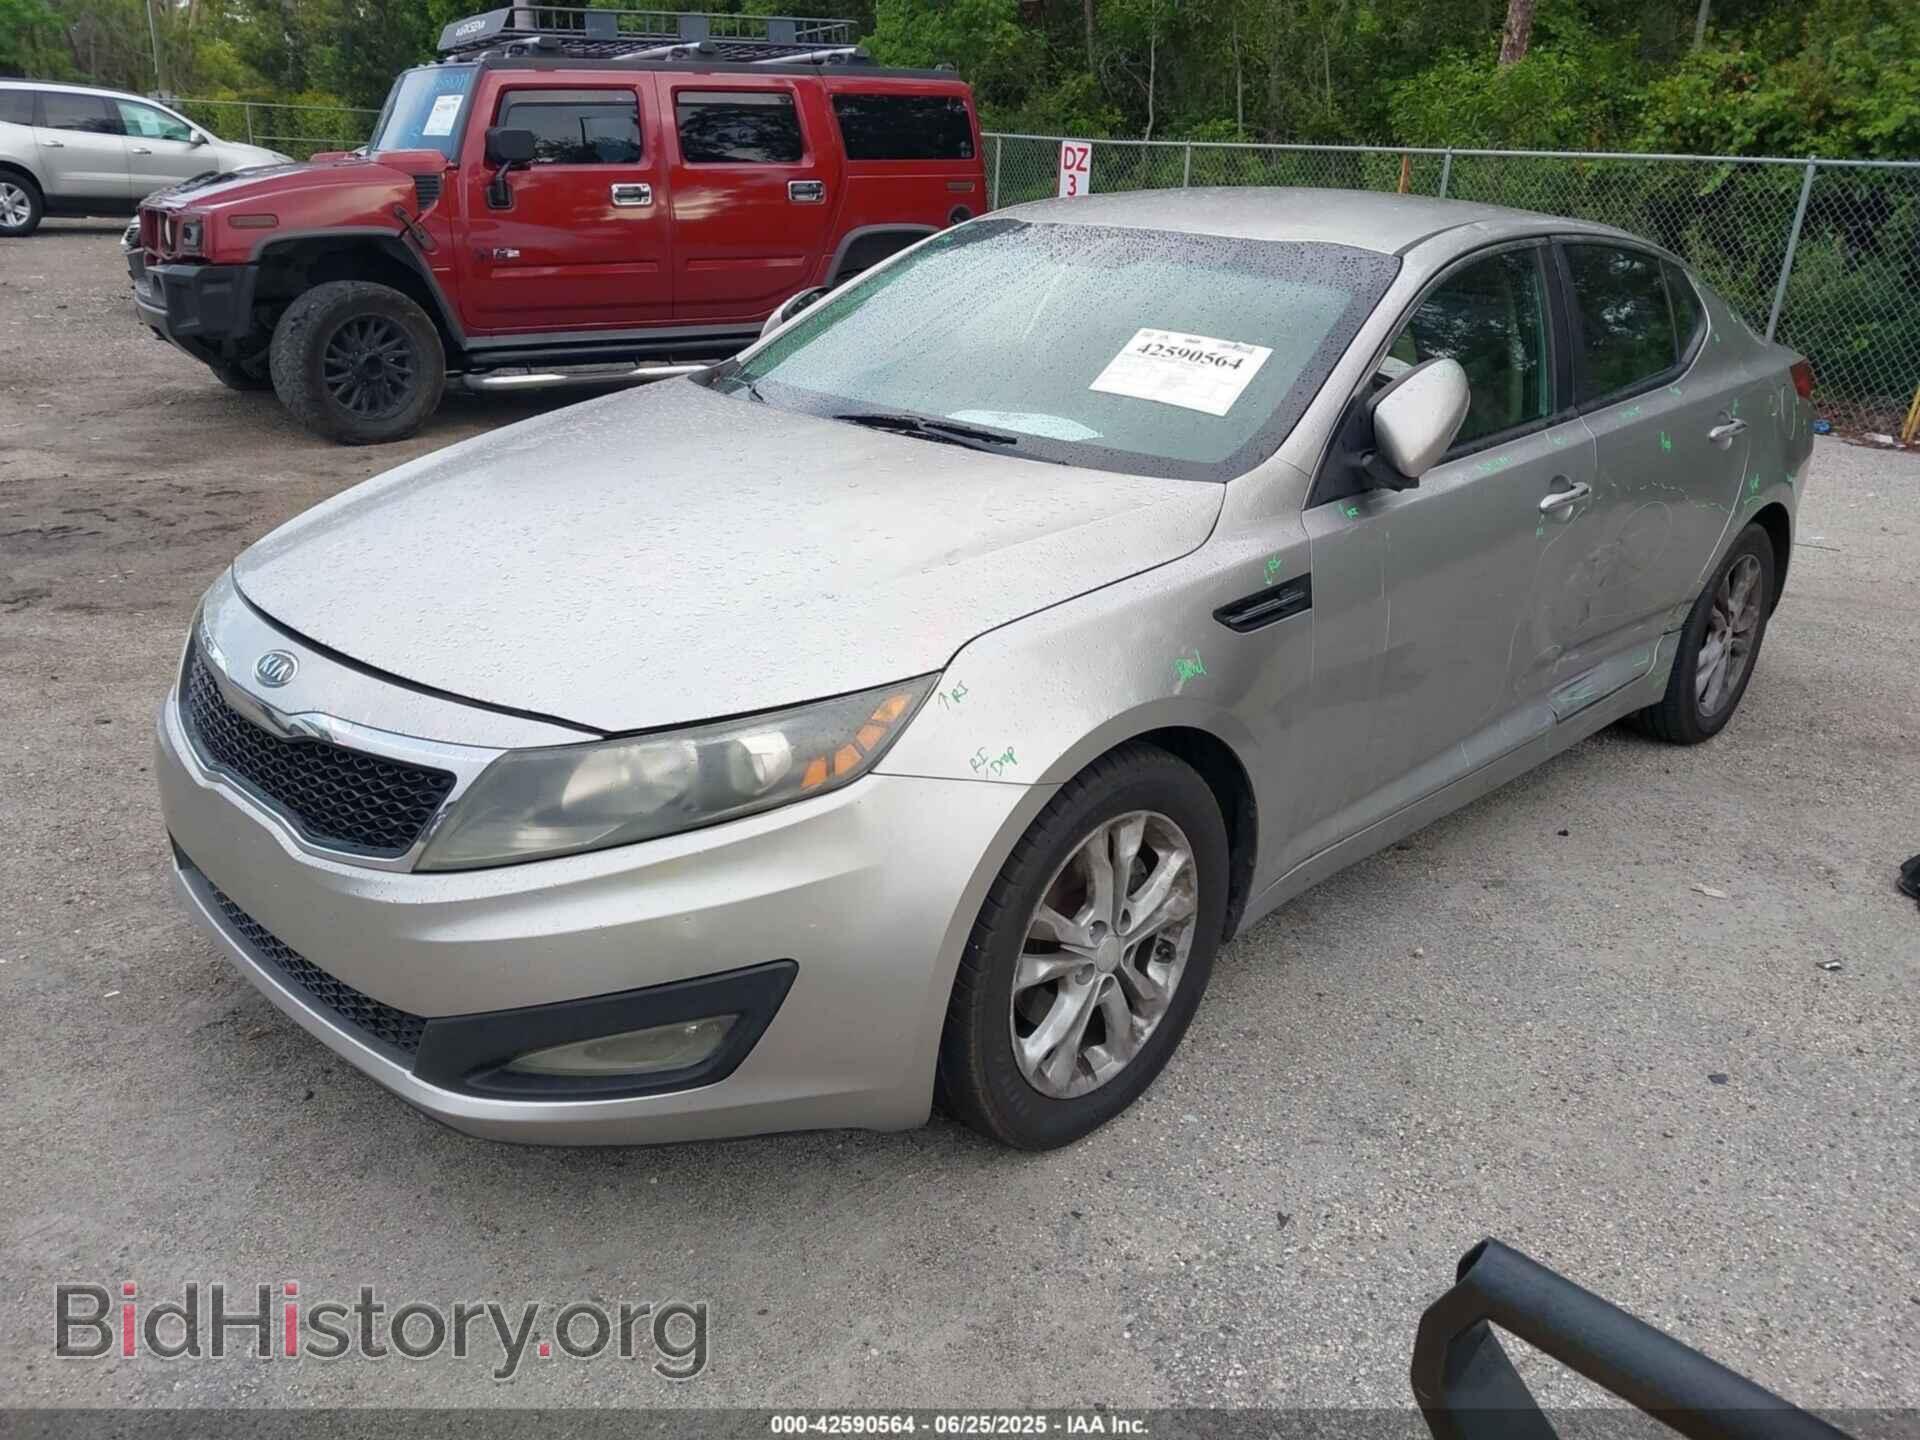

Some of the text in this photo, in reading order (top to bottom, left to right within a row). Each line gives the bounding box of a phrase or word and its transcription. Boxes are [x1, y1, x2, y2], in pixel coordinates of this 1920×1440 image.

[1063, 146, 1089, 172] DZ
[1067, 174, 1077, 196] 3
[1136, 343, 1244, 370] 42590564
[259, 655, 290, 681] KIA
